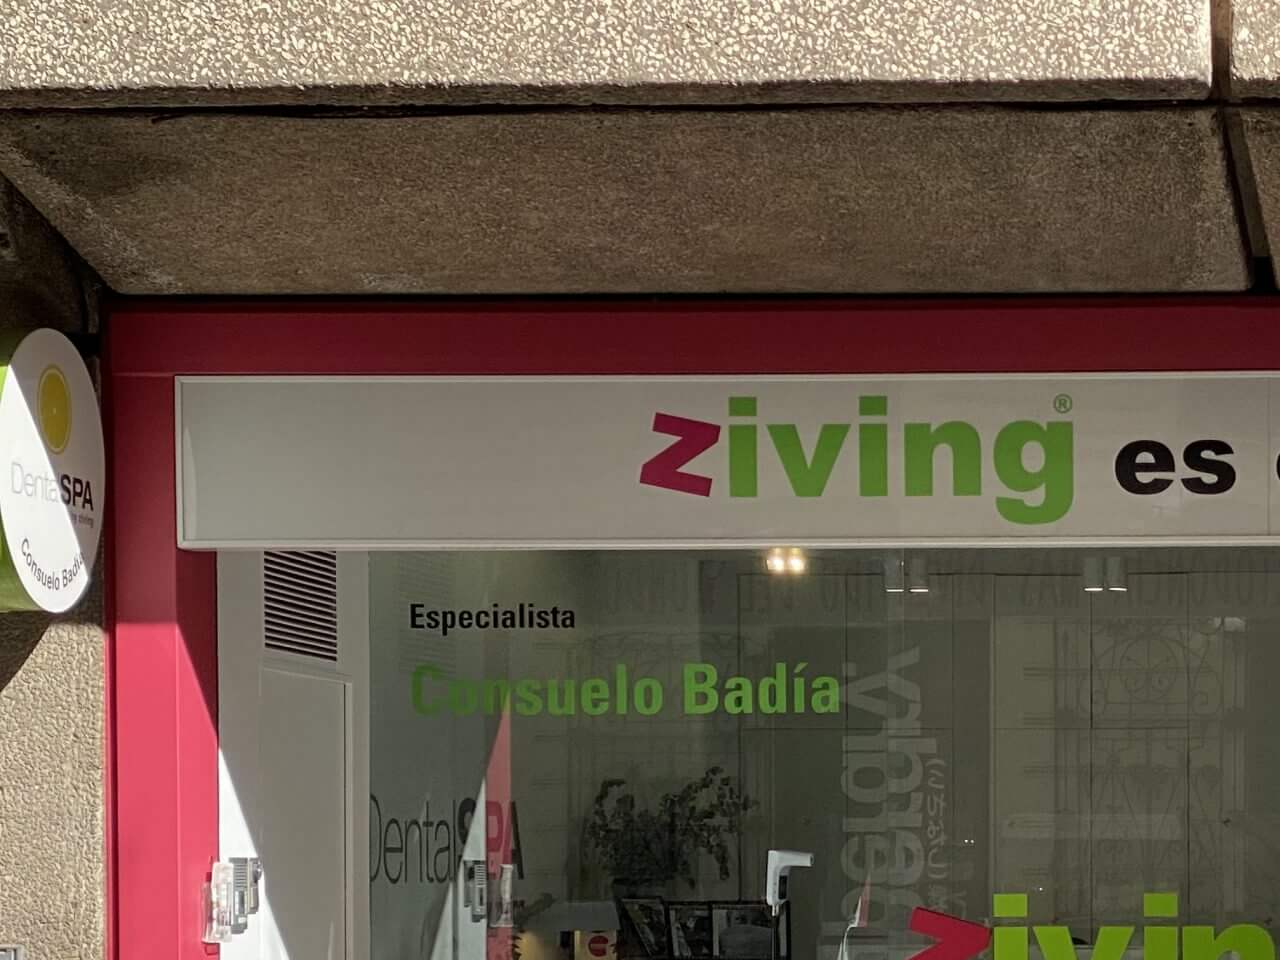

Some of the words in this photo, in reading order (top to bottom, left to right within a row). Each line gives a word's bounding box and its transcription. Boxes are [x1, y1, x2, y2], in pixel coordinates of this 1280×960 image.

[1114, 439, 1237, 495] es
[21, 538, 60, 591] Consuelo
[409, 603, 576, 636] Especialista
[411, 664, 663, 716] Consuelo
[684, 661, 841, 714] Badía
